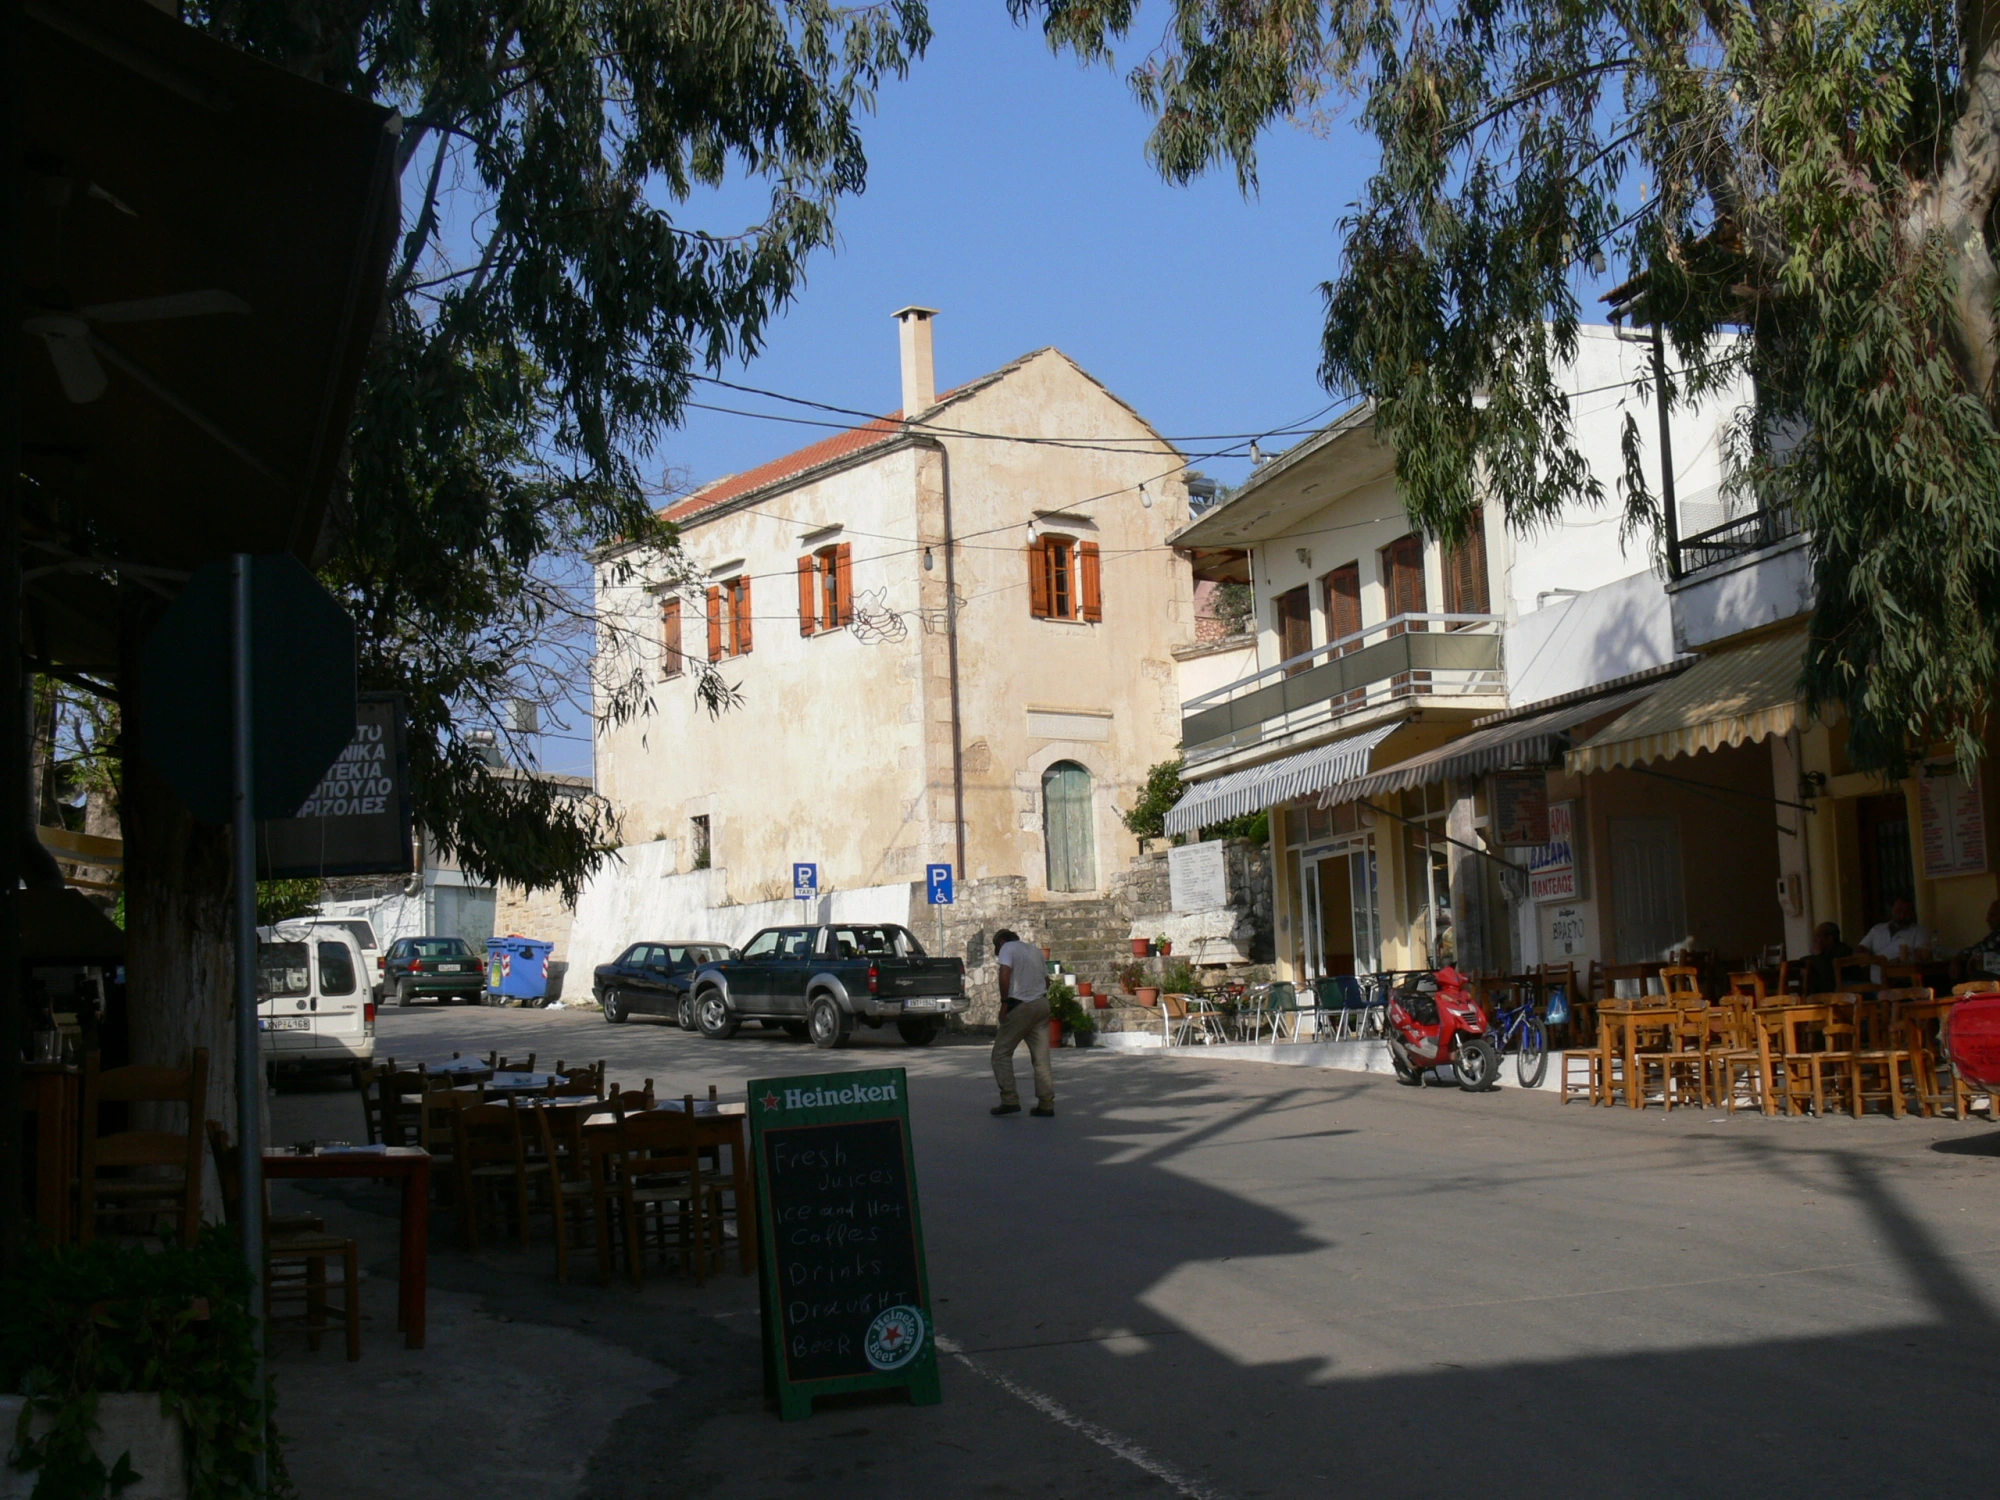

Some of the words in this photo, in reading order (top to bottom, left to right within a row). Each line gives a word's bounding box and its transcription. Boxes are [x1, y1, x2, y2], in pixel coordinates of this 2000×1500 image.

[351, 724, 382, 742] ΤΟ
[338, 743, 386, 762] ΝΙΚΑ
[327, 761, 382, 781] ΤΕΚΙΑ
[1549, 807, 1571, 835] ΑΡΙΑ
[932, 869, 948, 886] P
[784, 1083, 898, 1109] Heineken
[774, 1142, 847, 1174] Fresh
[776, 1204, 812, 1224] Ice
[819, 1200, 854, 1218] and
[867, 1200, 904, 1218] Hot
[788, 1253, 882, 1287] Drinks
[873, 1309, 916, 1345] Heineken
[869, 1341, 896, 1362] Beer
